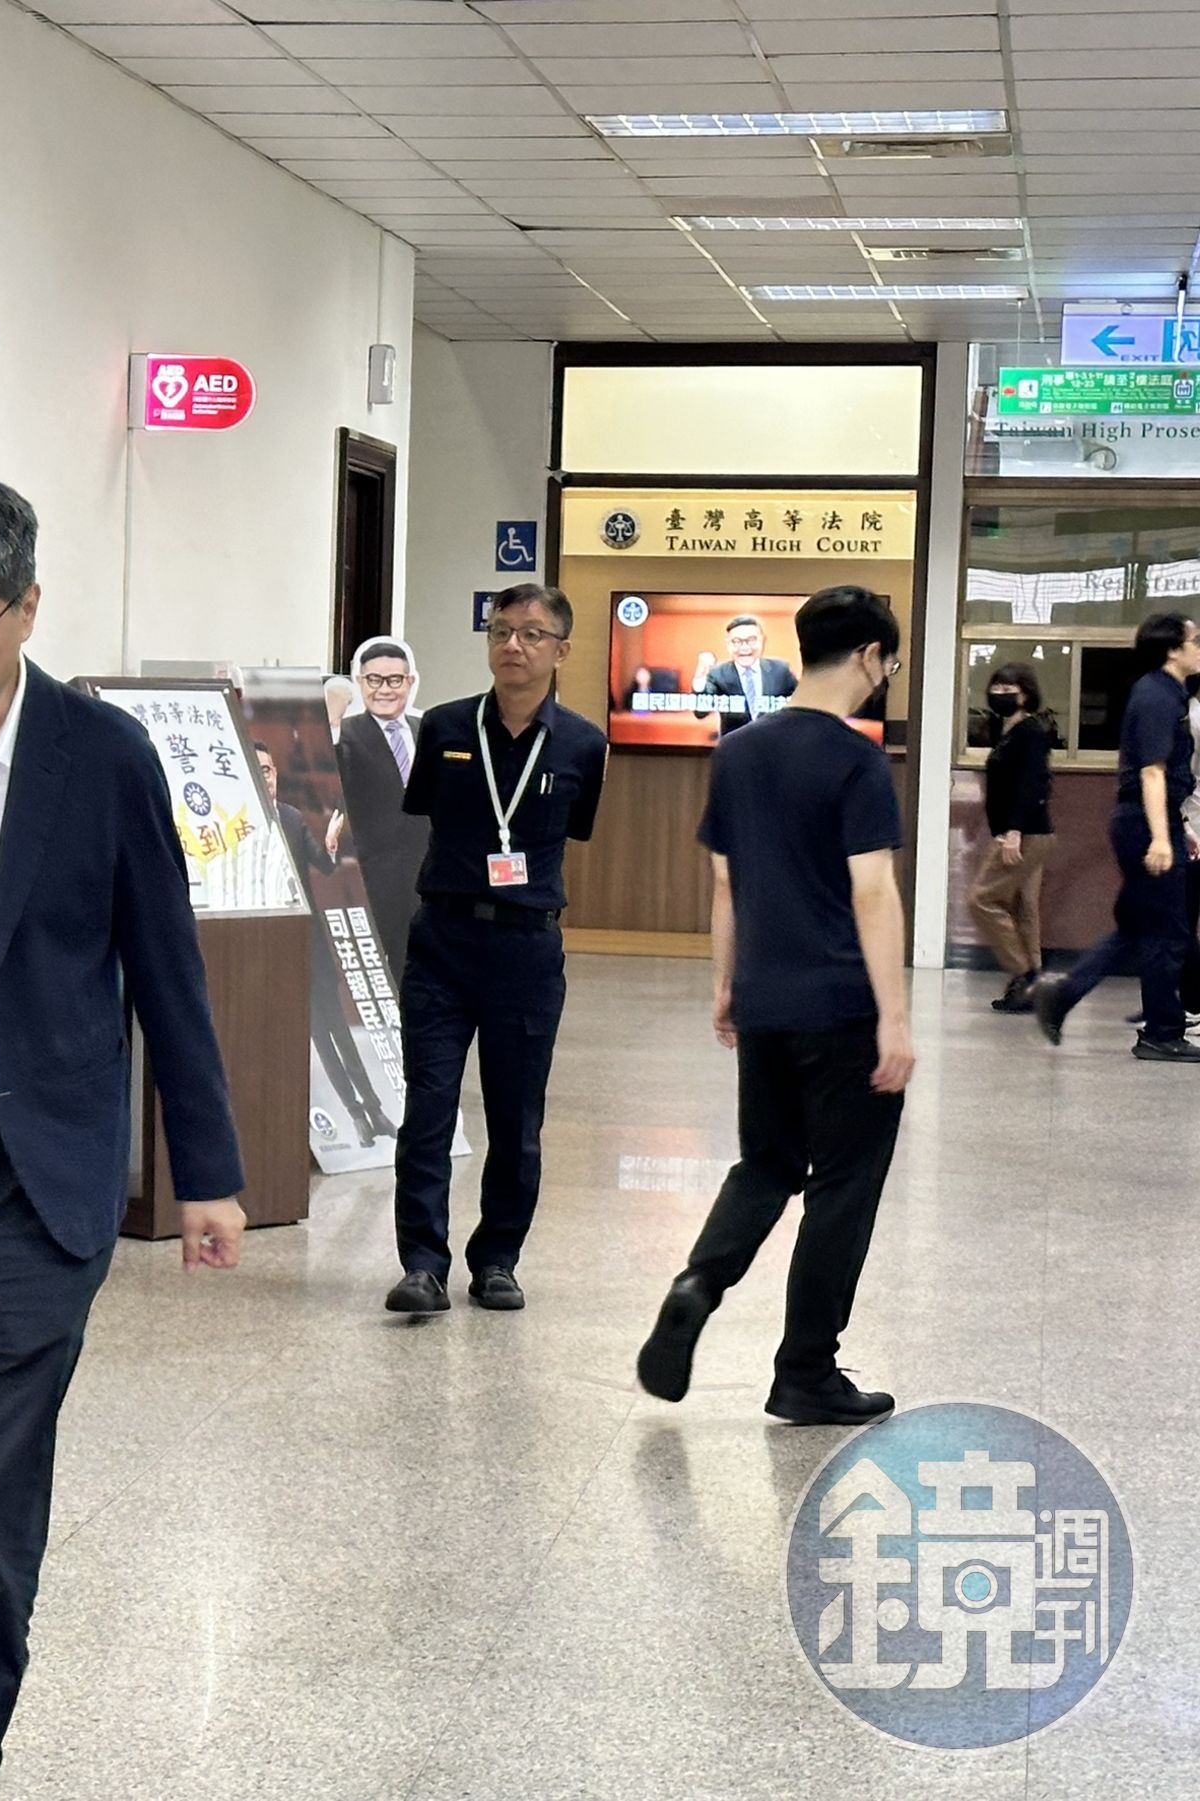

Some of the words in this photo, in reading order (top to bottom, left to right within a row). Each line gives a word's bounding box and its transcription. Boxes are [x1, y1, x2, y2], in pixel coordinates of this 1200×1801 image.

[1120, 354, 1159, 362] EXIT
[192, 374, 238, 392] AED
[1082, 422, 1132, 442] High
[1141, 423, 1200, 438] Prose
[665, 508, 883, 532] 臺灣高等法院
[665, 536, 737, 551] TAIWAN
[751, 536, 803, 552] HIGH
[817, 537, 882, 552] COURT
[346, 907, 403, 1050] 國民逗陣
[324, 908, 407, 1100] 司法親民做伙
